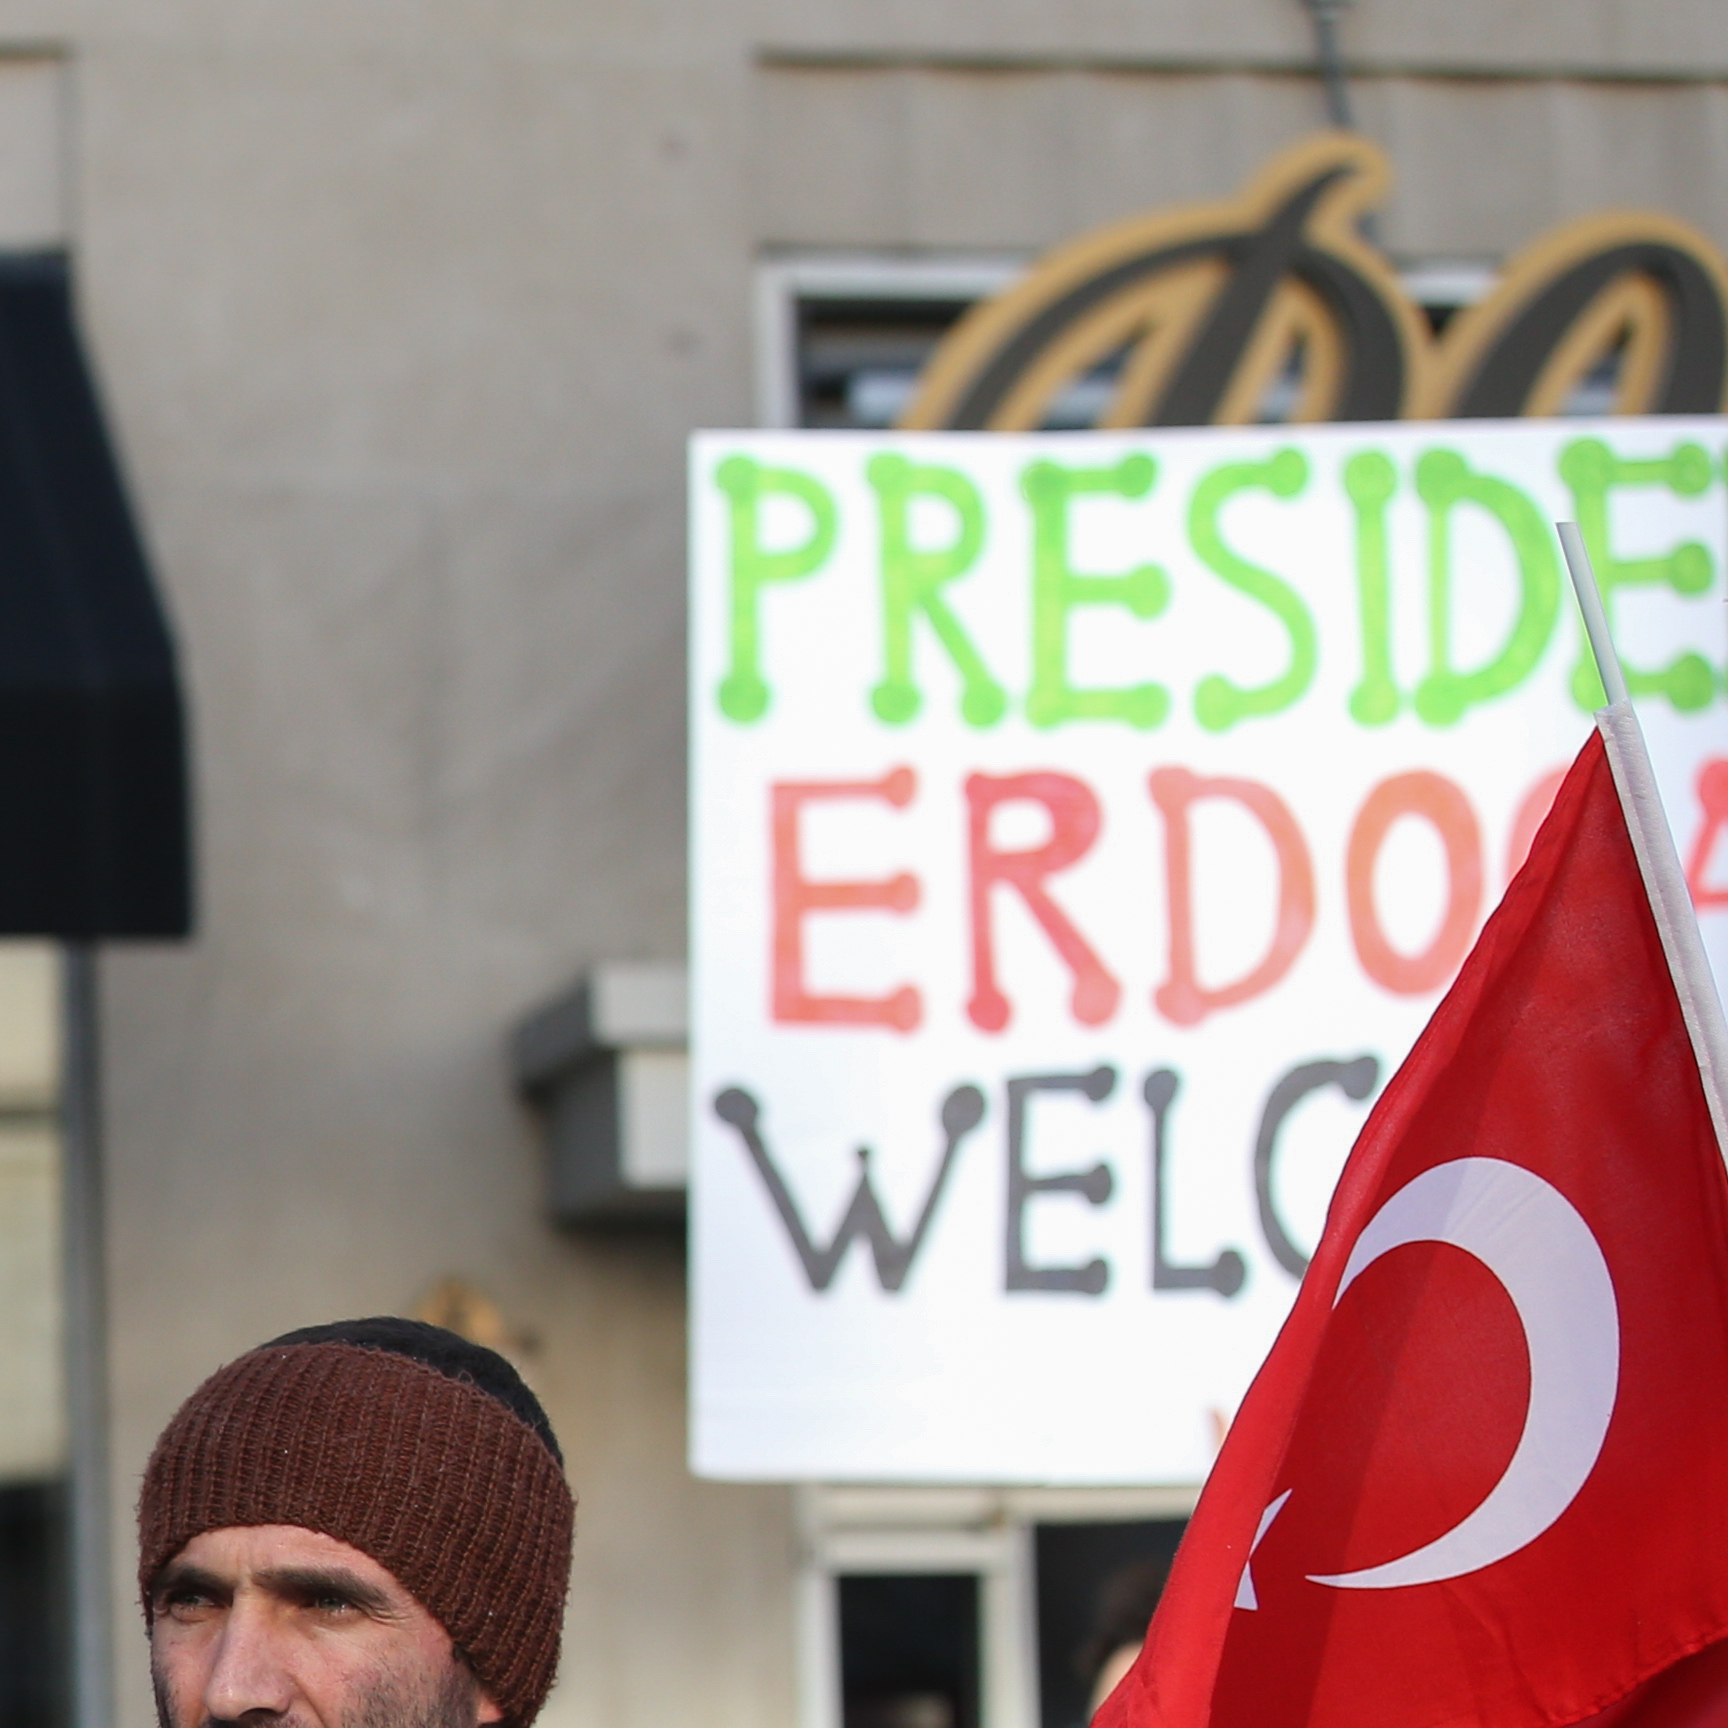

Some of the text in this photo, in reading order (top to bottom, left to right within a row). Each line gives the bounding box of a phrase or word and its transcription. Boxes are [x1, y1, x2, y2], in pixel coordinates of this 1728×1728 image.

[714, 437, 1728, 731] PRESIDE
[767, 757, 1728, 1032] ERDO
[715, 1052, 1382, 1297] WELC
